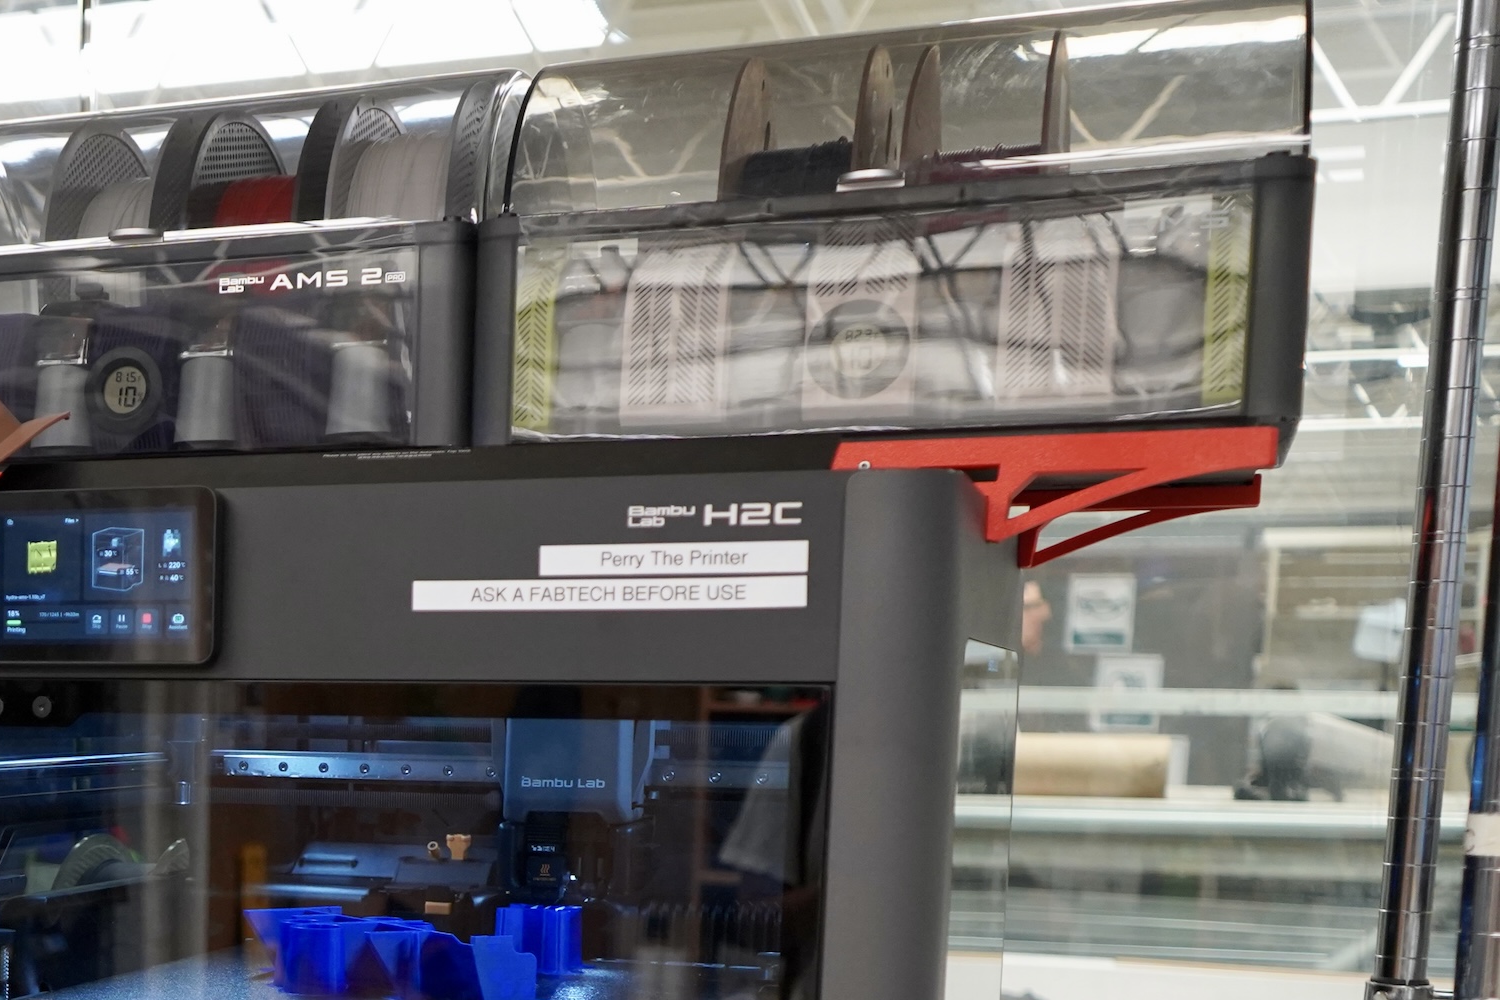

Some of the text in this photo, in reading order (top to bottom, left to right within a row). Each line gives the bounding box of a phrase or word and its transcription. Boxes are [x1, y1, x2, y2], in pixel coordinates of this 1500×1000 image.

[219, 276, 265, 286] Bambu
[269, 267, 405, 291] AMS 2 PRO
[219, 285, 245, 294] Lab
[118, 386, 137, 408] 10
[627, 504, 696, 518] Bambu
[702, 502, 803, 527] H2C
[627, 516, 666, 527] Lab
[600, 549, 749, 569] Perry The Printer
[471, 583, 747, 603] ASK A FABTECH BEFORE USE
[6, 626, 26, 635] Printing
[521, 776, 606, 788] Bambu Lab
